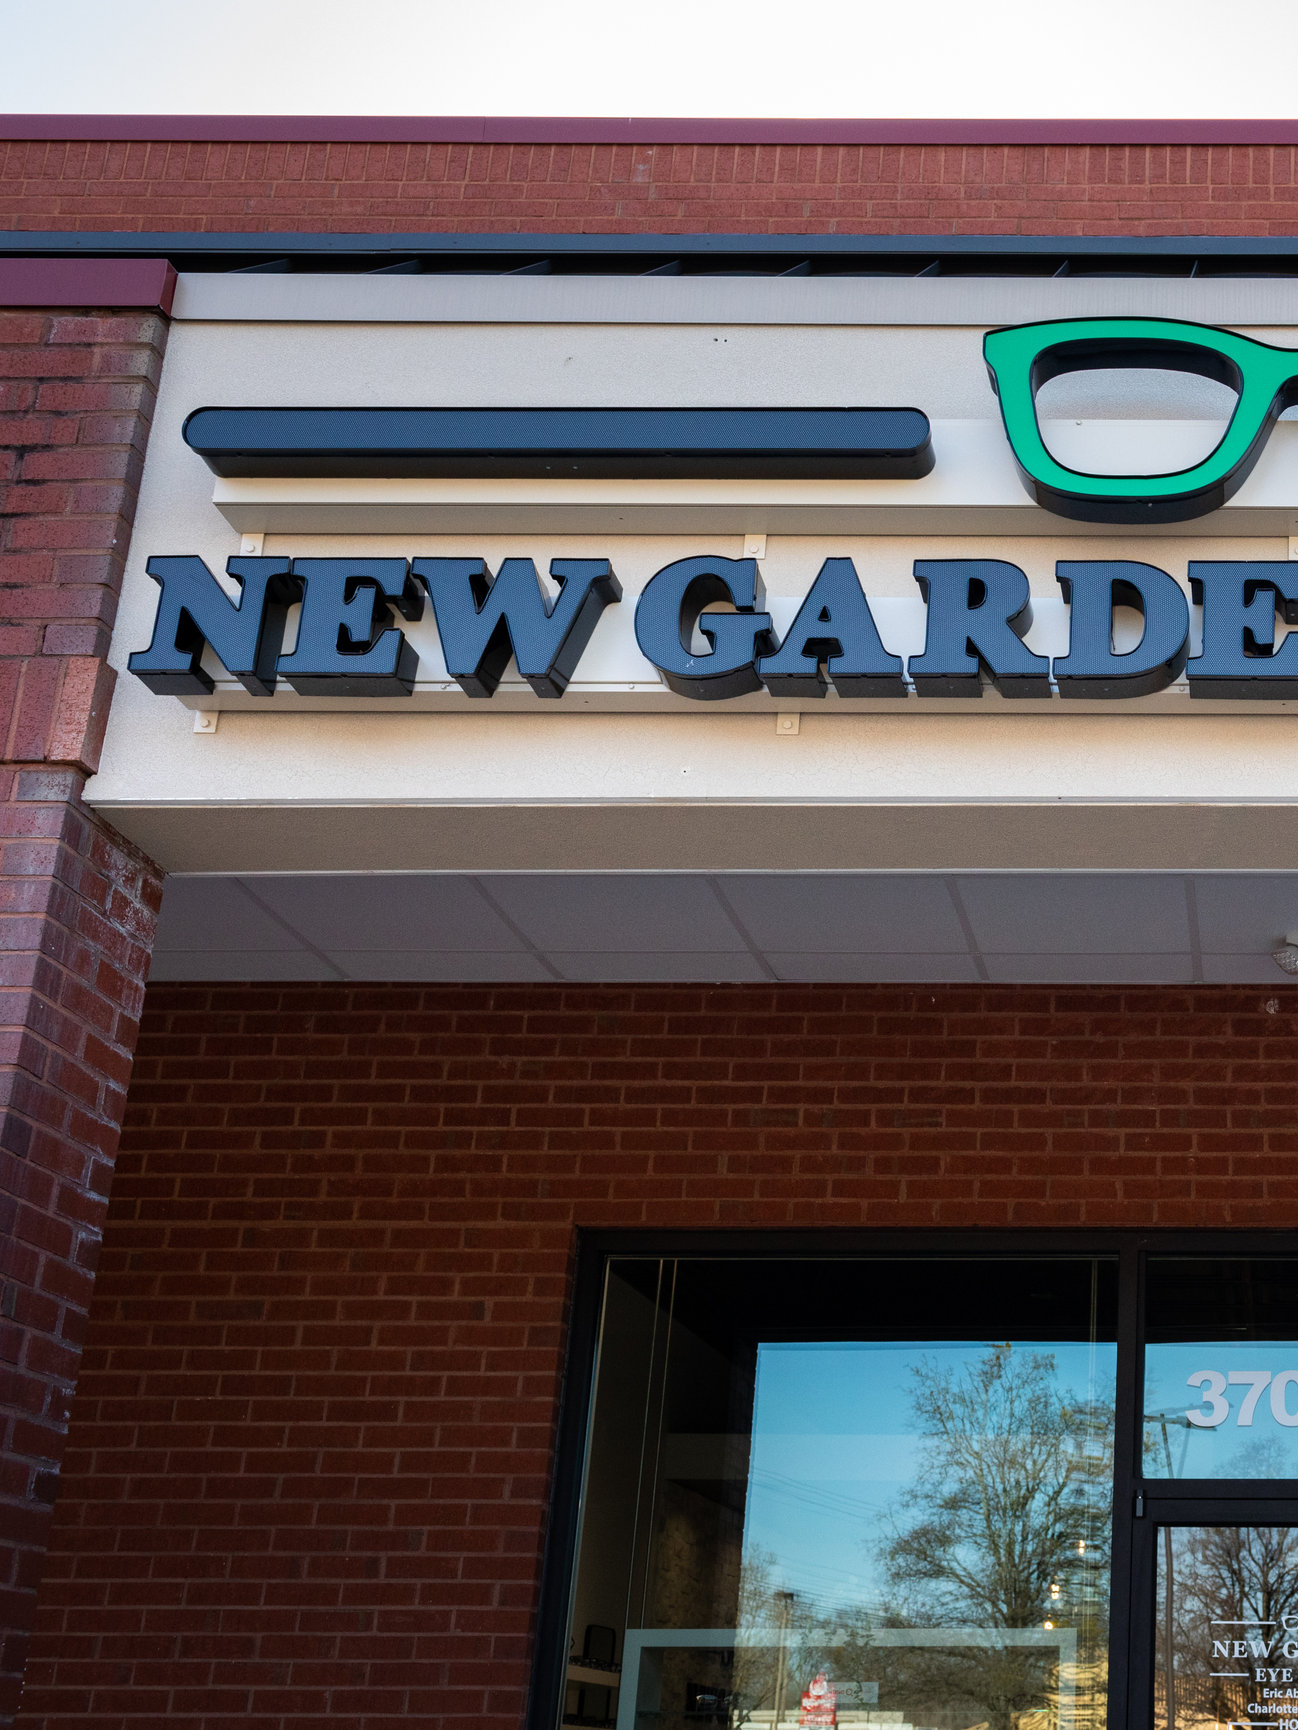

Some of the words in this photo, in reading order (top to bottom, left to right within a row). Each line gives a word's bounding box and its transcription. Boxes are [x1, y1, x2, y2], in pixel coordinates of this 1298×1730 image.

[128, 554, 622, 697] NEW
[1211, 1639, 1273, 1659] NEW
[1254, 1667, 1294, 1683] EYE
[1262, 1687, 1284, 1700] Eric
[1246, 1702, 1298, 1715] Charlotte
